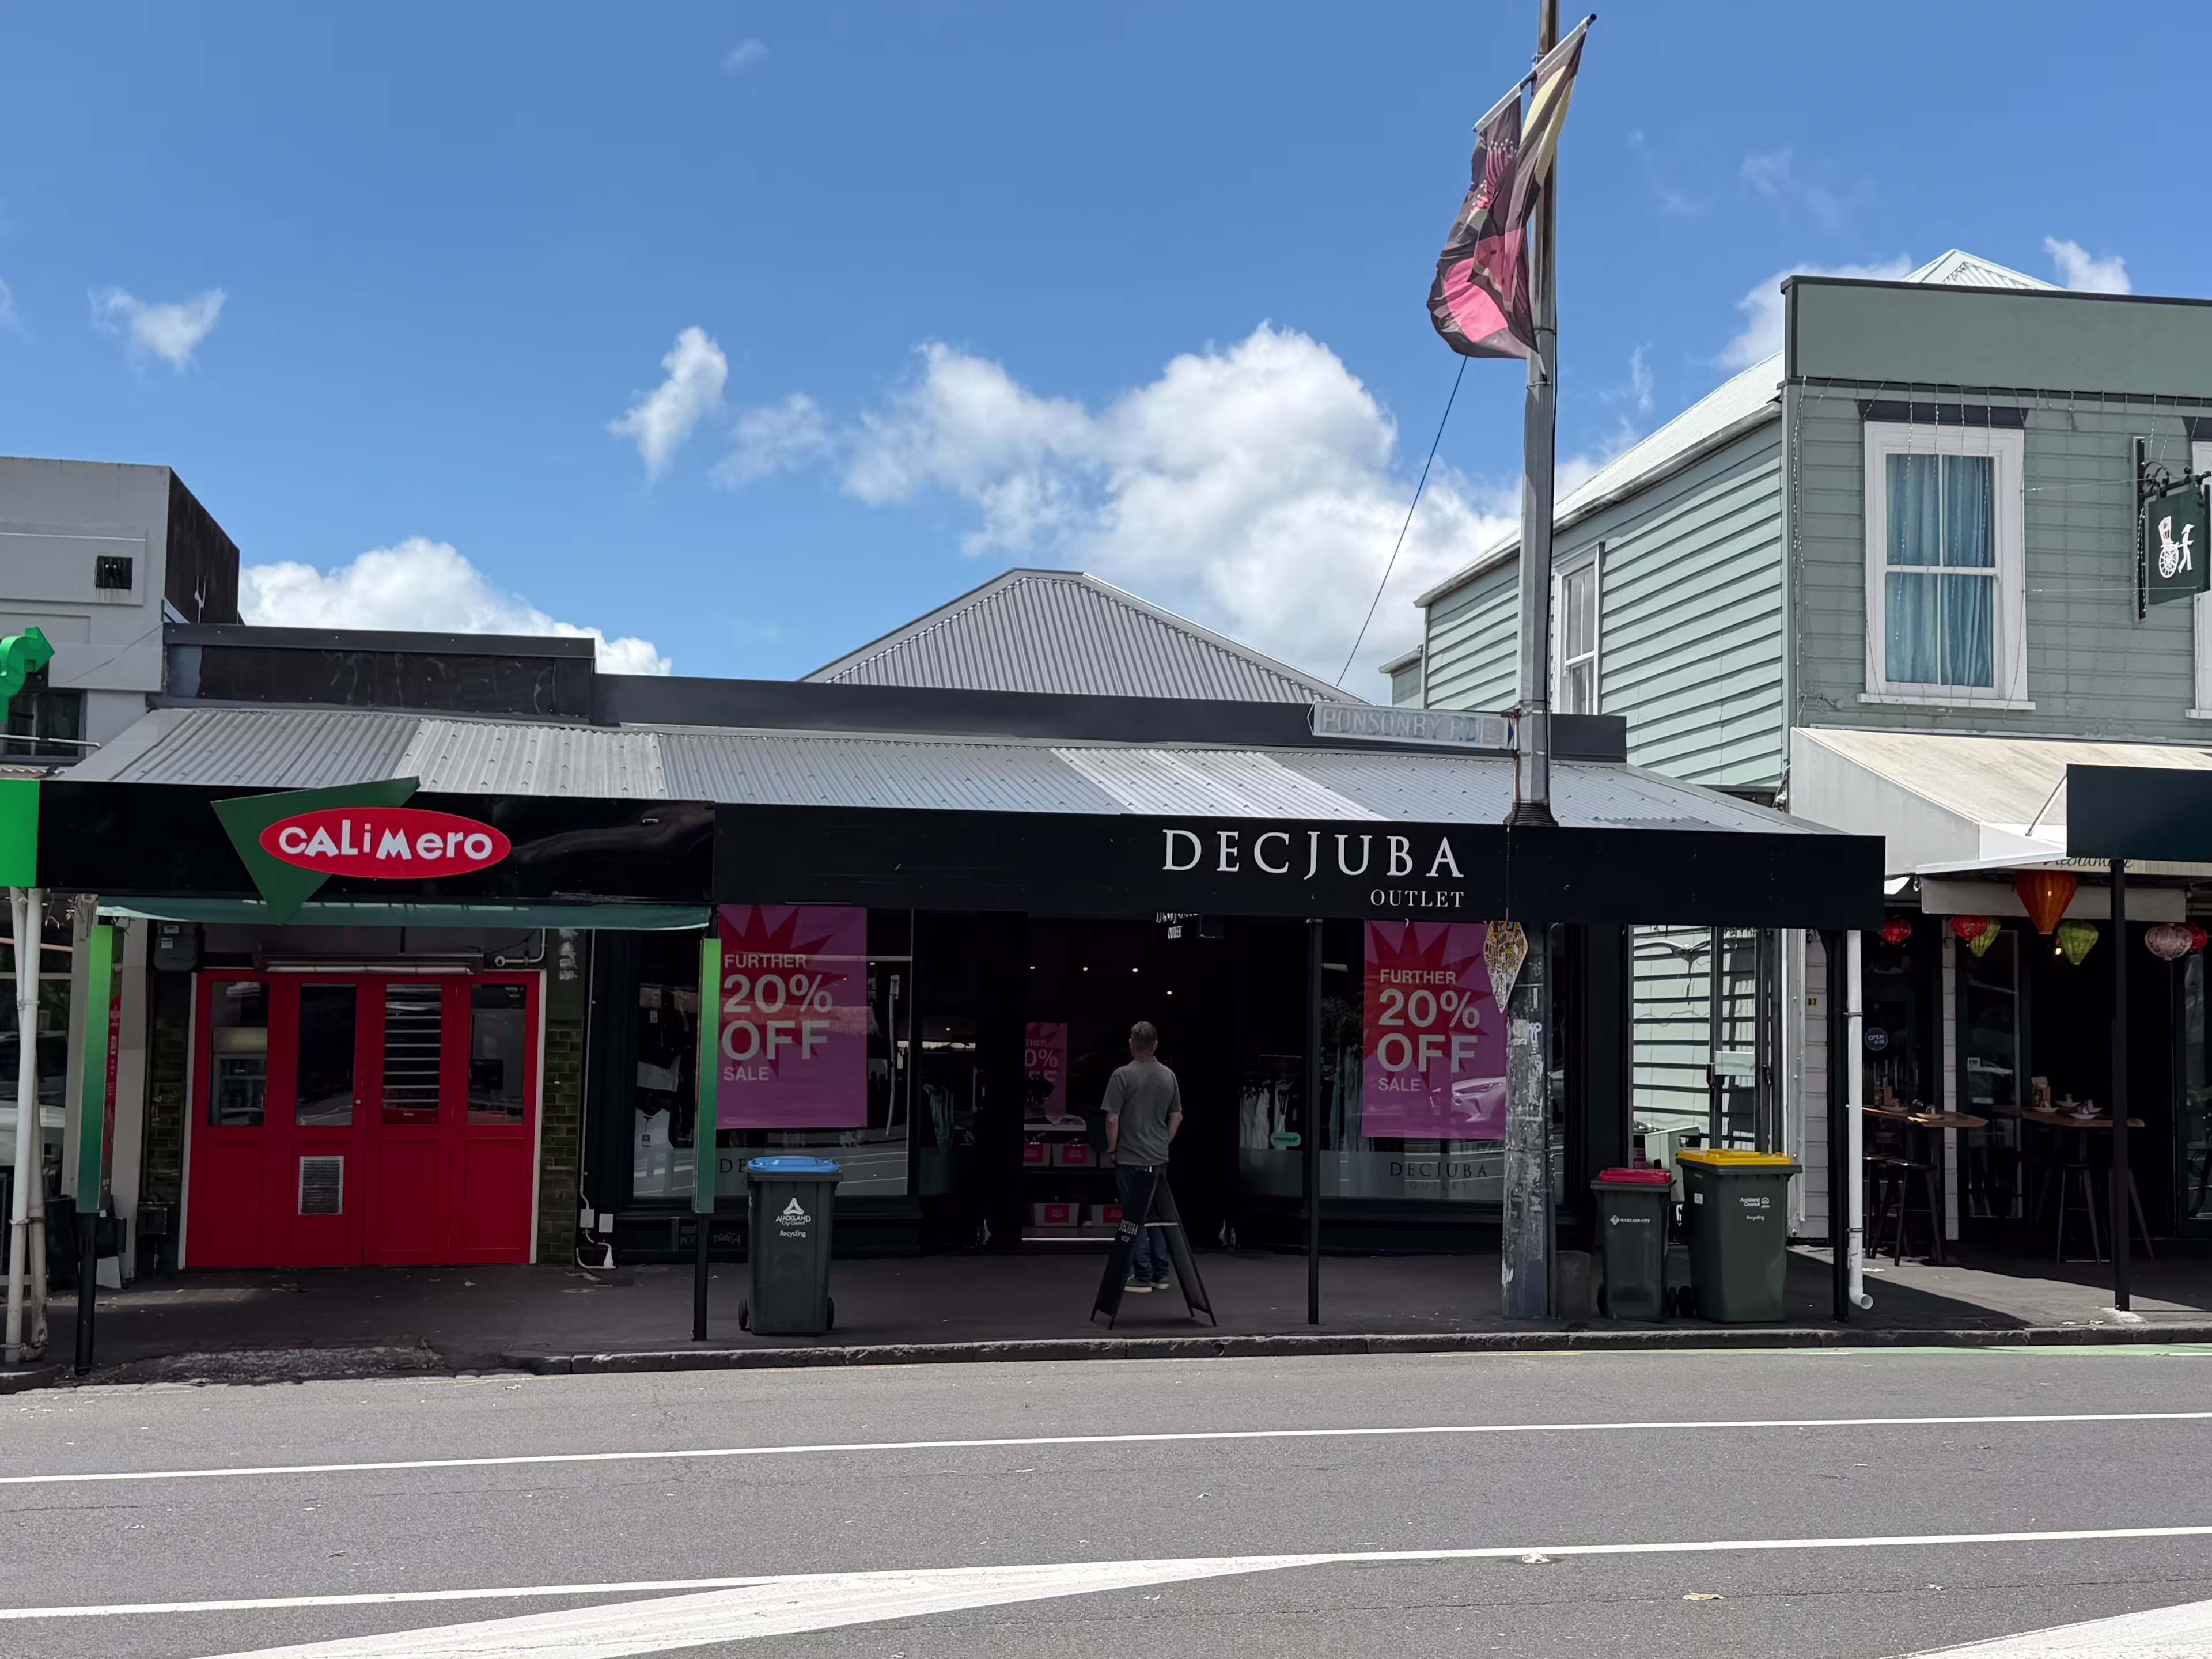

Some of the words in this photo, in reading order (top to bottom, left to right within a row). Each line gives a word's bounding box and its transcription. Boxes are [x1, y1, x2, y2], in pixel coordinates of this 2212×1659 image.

[1323, 708, 1441, 739] PONSONBY
[1450, 715, 1479, 742] RD
[1162, 829, 1464, 880] DECJUBA
[1370, 889, 1465, 908] OUTLET
[724, 953, 806, 969] FURTHER
[1380, 968, 1457, 985] FURTHER
[723, 974, 833, 1013] 20%
[1377, 988, 1480, 1029] 20%
[722, 1020, 830, 1060] OFF
[1024, 1048, 1059, 1068] 0%
[1376, 1032, 1479, 1074] OFF
[723, 1066, 770, 1081] SALE
[1377, 1077, 1421, 1092] SALE
[1389, 1161, 1488, 1177] DECJUBA
[1409, 1181, 1467, 1191] OUTLET
[775, 1215, 812, 1223] AUCKLAND
[779, 1230, 807, 1238] Recycling
